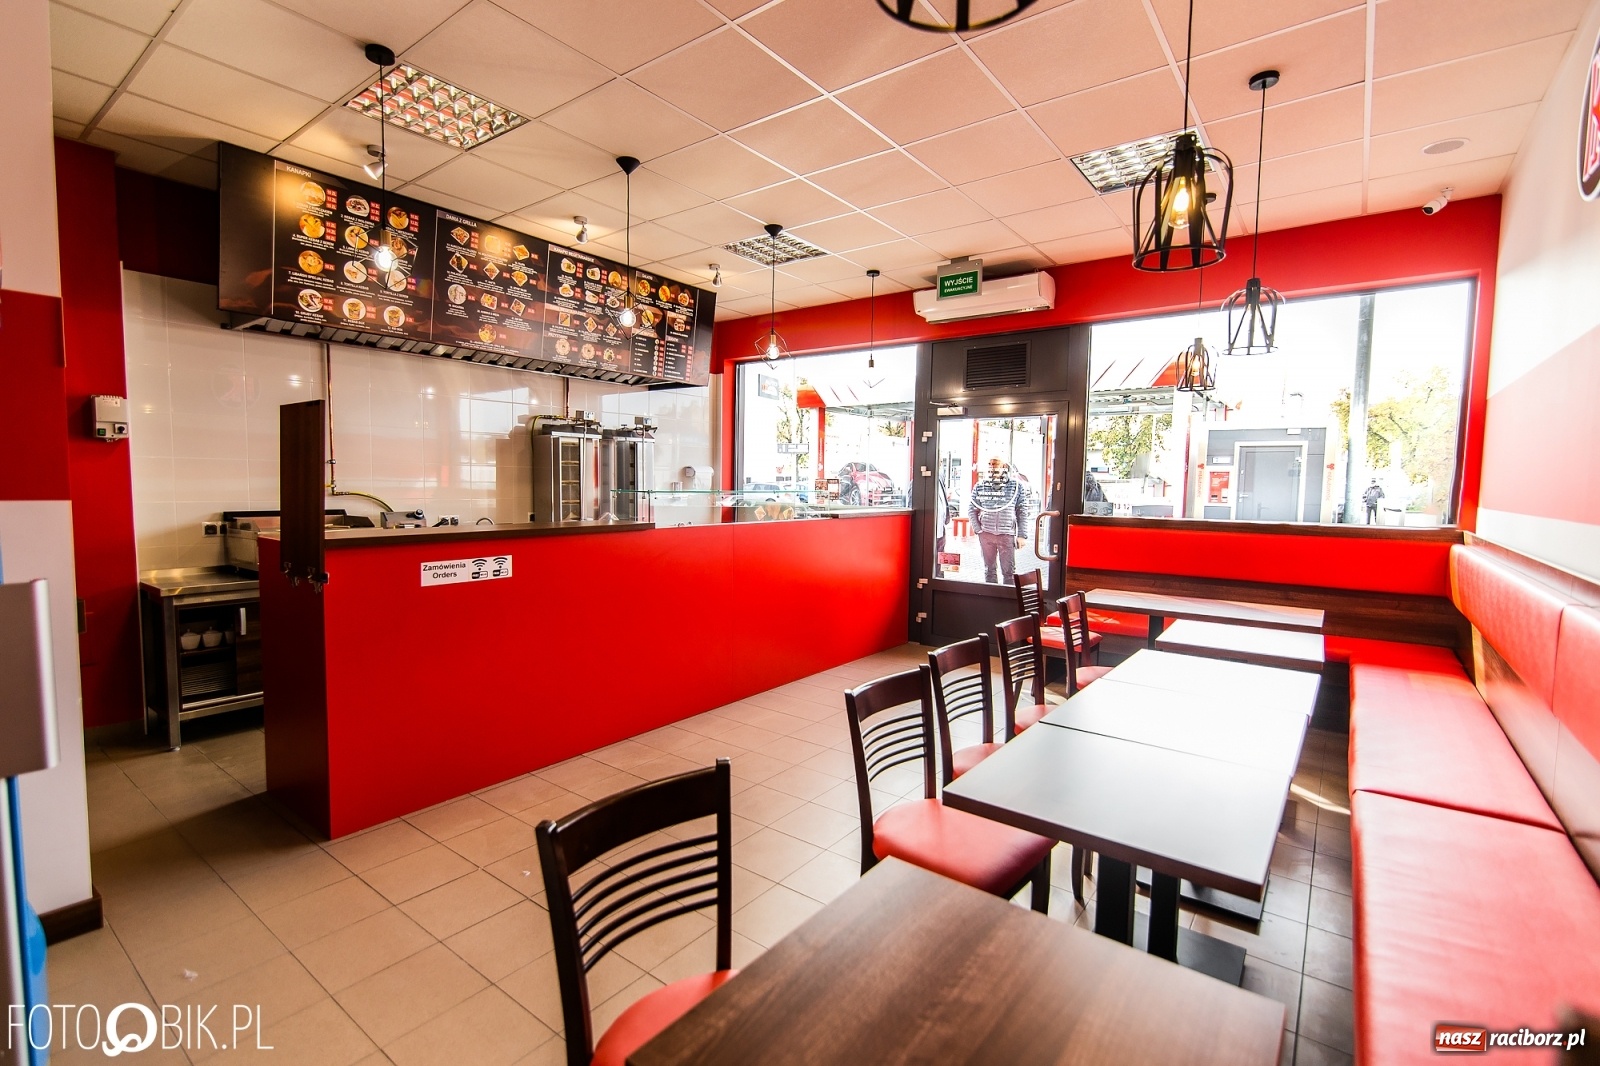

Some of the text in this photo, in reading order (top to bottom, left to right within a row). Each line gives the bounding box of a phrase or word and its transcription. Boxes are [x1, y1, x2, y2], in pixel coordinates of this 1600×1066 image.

[286, 166, 312, 178] KANAPKI
[944, 277, 973, 287] WYJŚCIE
[423, 562, 466, 571] Zamówienia
